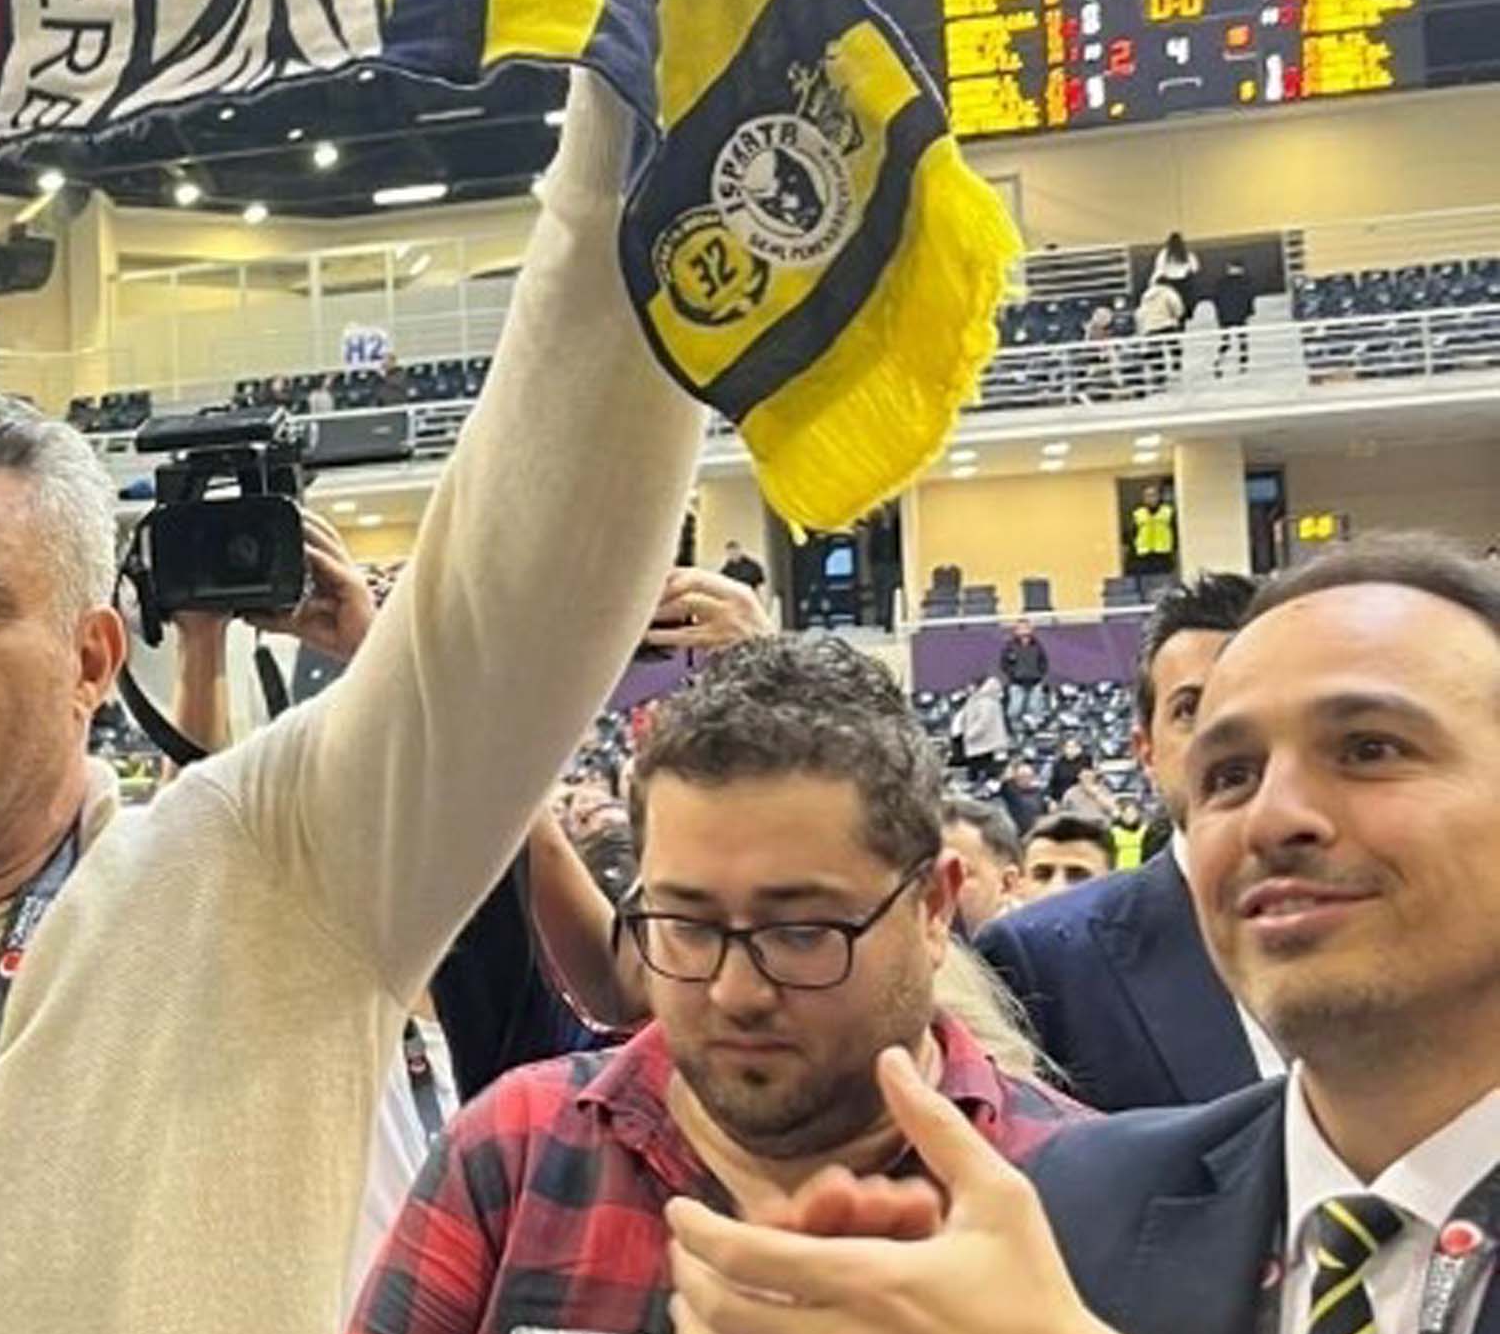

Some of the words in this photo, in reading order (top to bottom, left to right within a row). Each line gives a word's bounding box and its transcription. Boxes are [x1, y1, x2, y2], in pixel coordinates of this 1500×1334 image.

[1166, 38, 1190, 65] 4
[718, 121, 799, 214] ISPARTA
[690, 236, 738, 299] 32
[346, 334, 384, 363] H2
